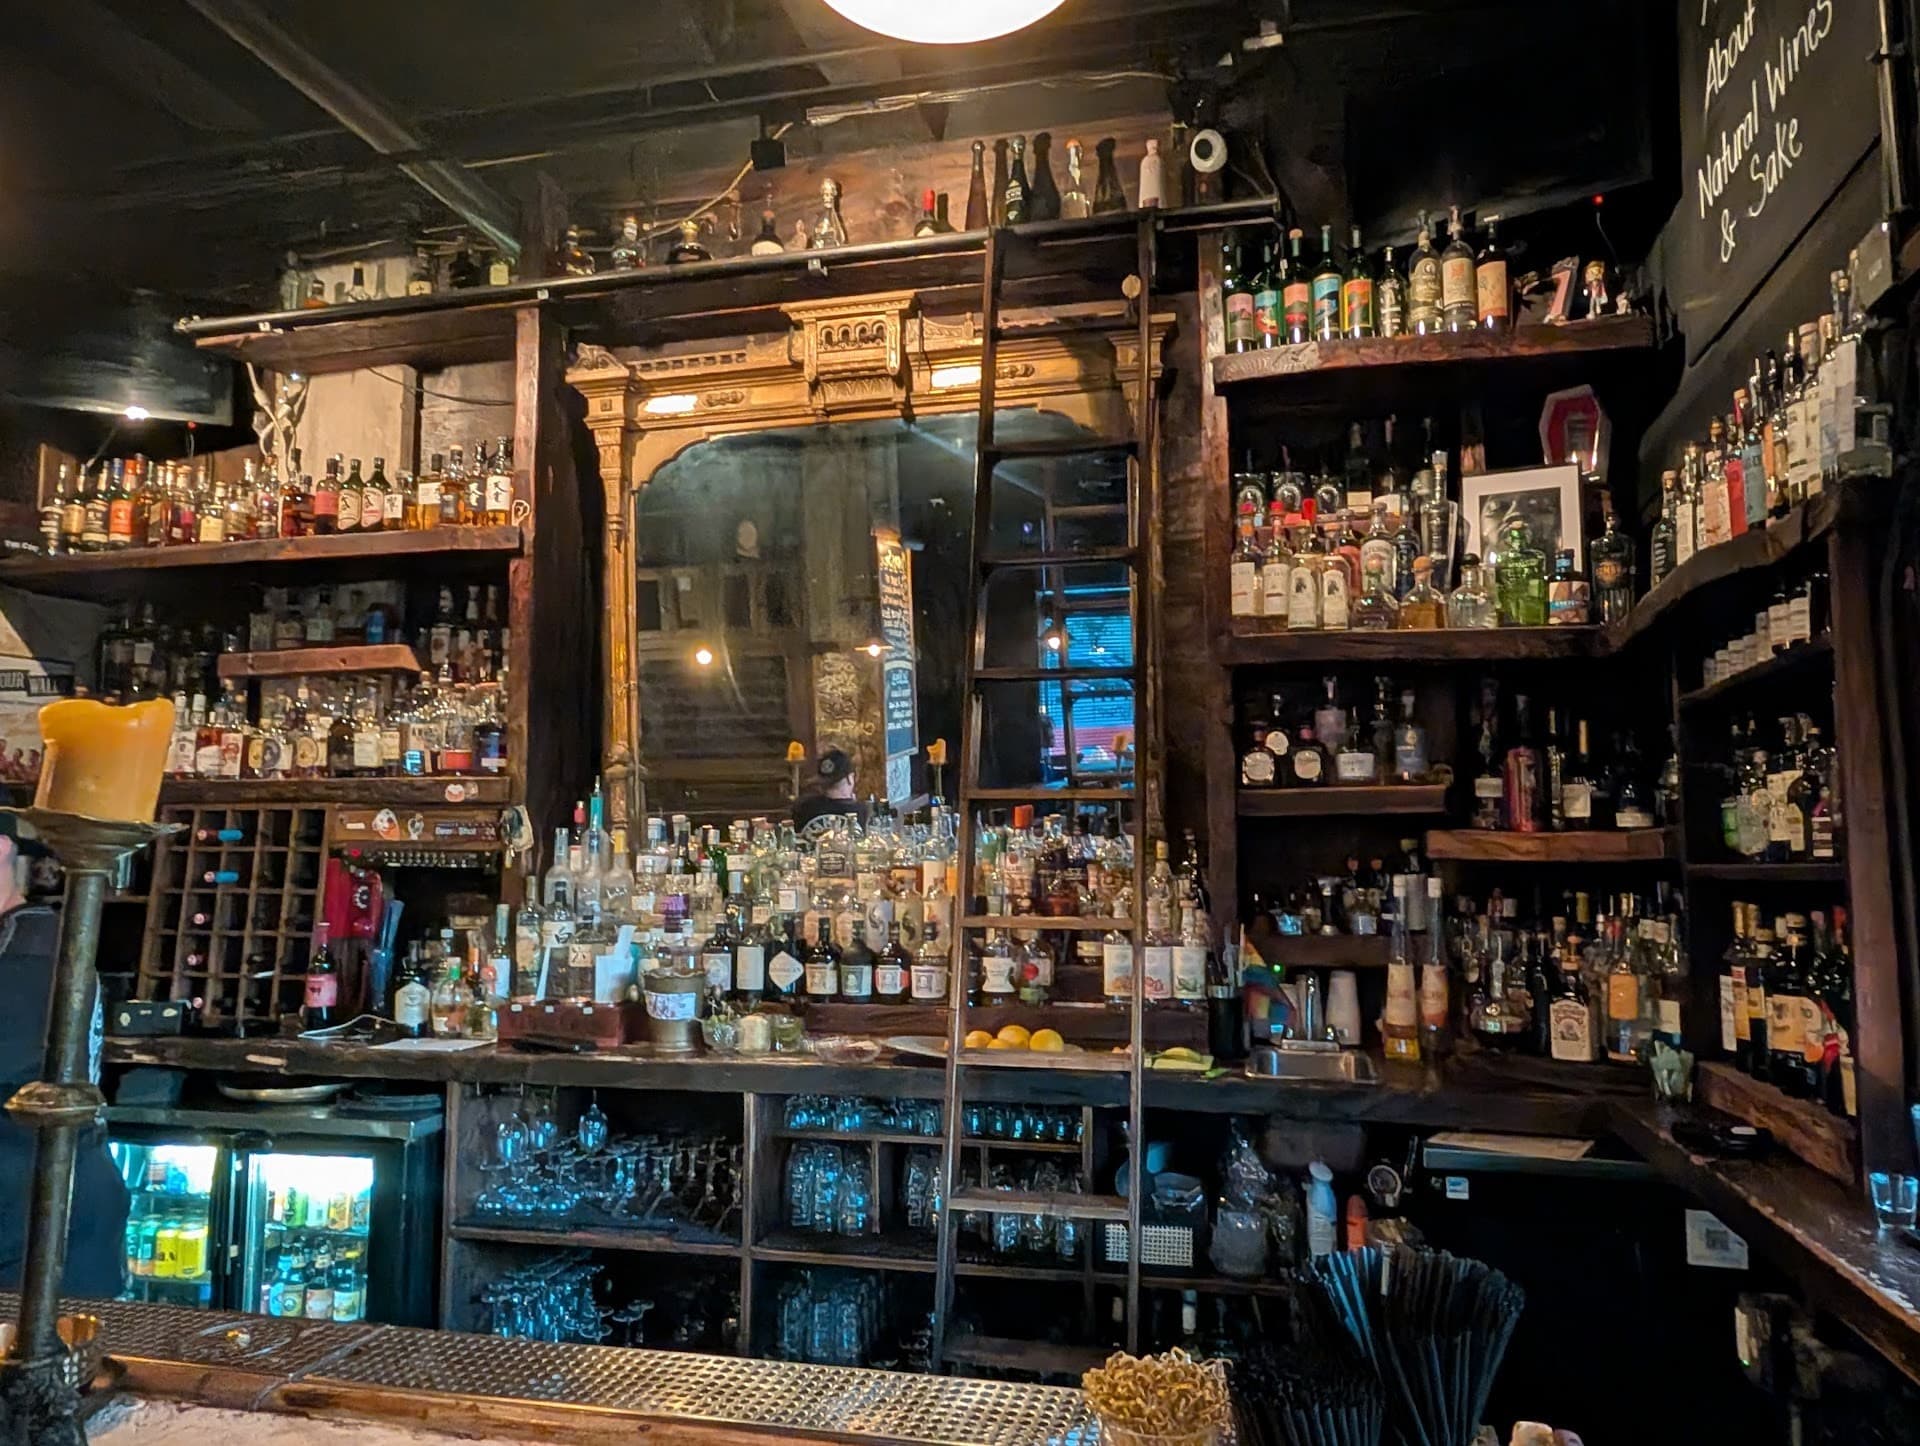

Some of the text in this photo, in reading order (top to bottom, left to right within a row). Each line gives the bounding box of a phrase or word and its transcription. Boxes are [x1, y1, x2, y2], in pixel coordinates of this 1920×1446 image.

[1698, 0, 1833, 219] Natural Wines
[1704, 0, 1756, 113] About
[1720, 117, 1803, 264] & Sake
